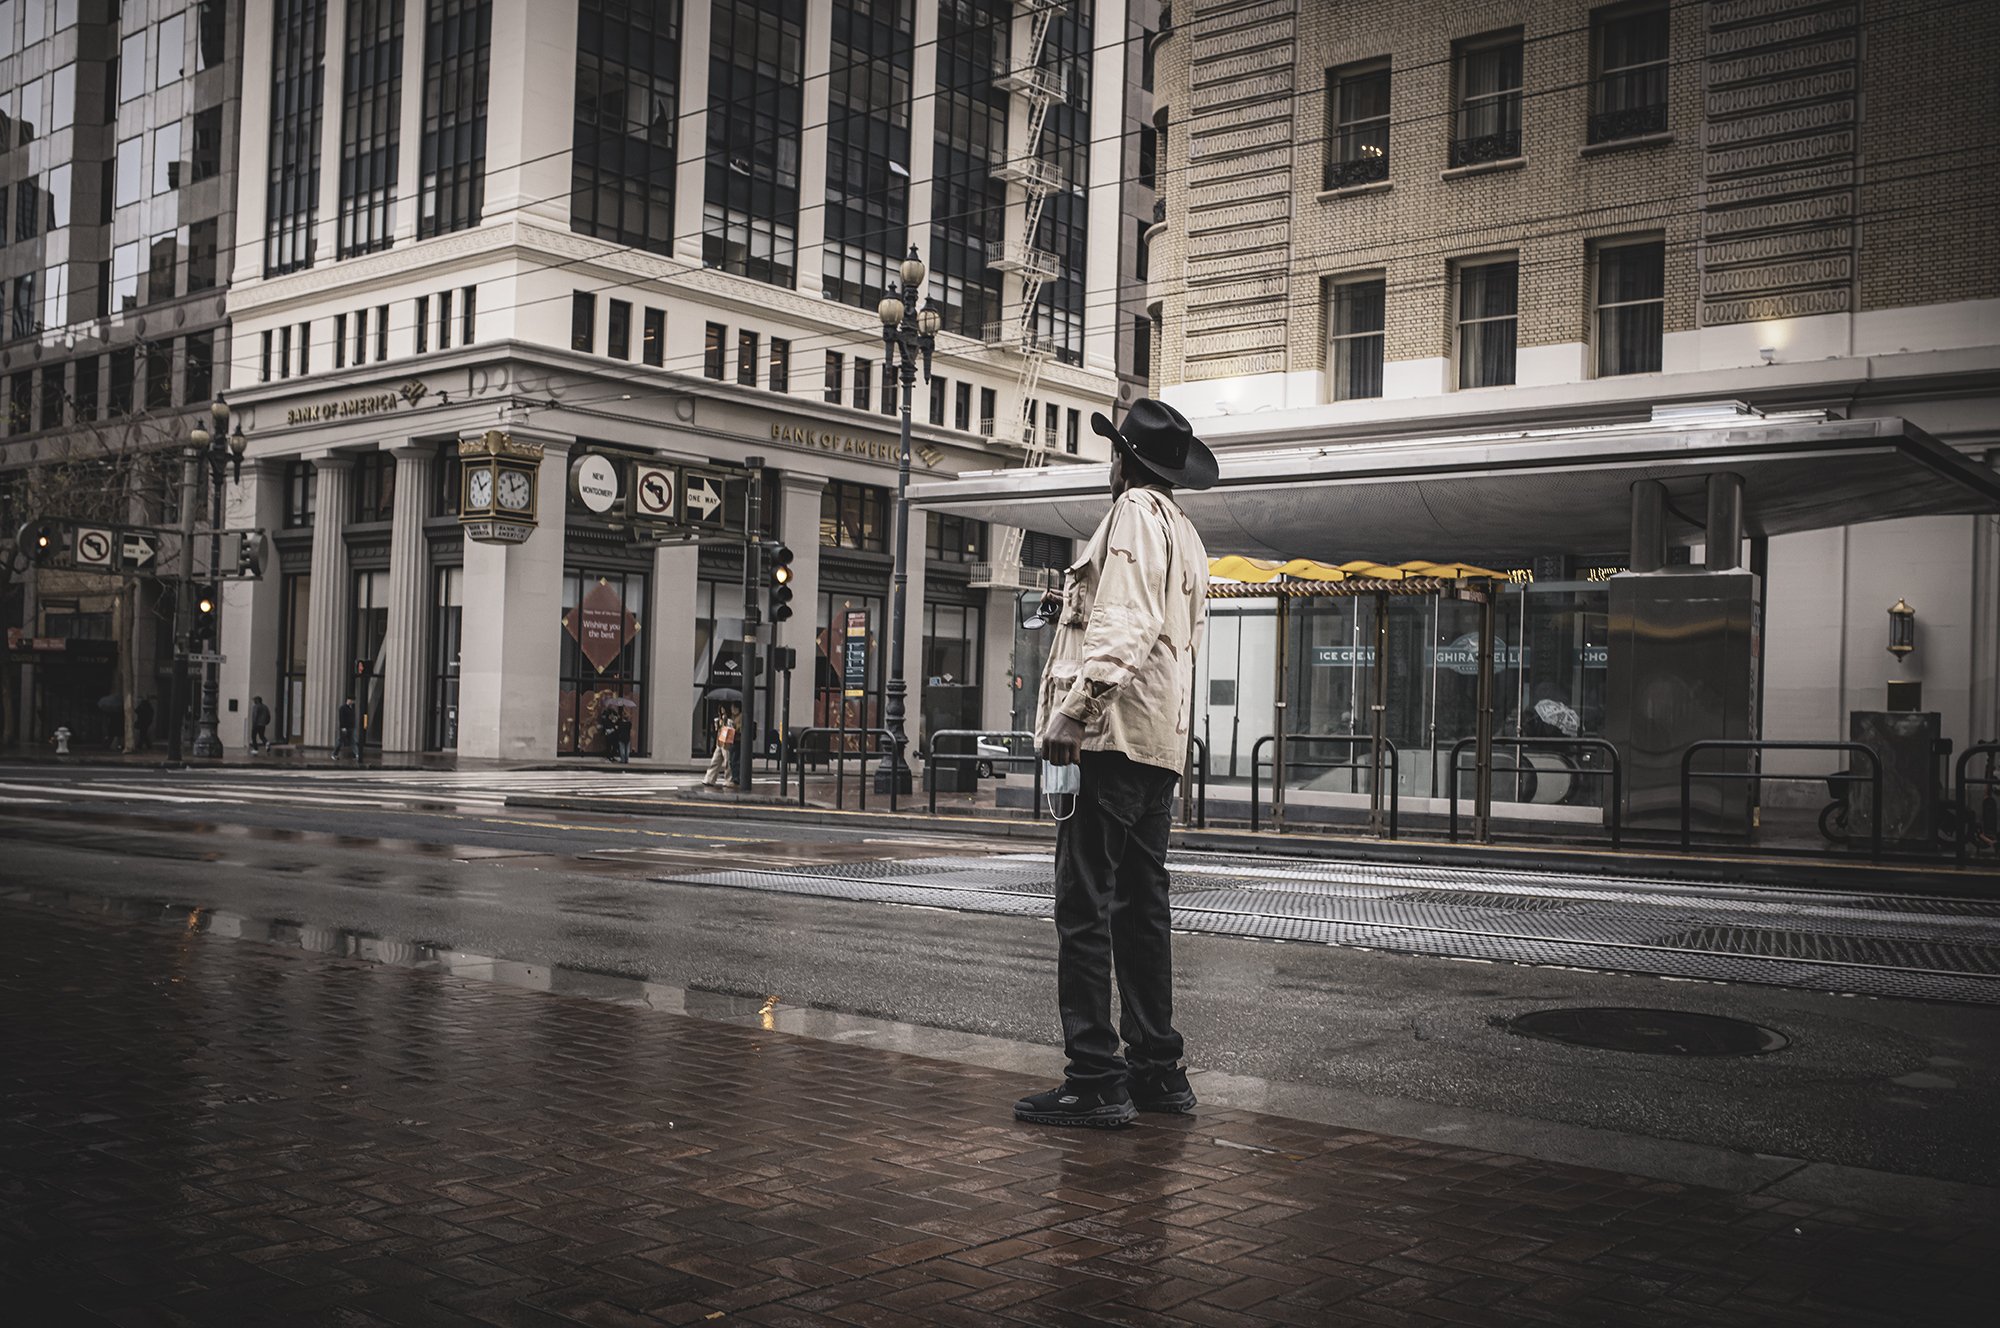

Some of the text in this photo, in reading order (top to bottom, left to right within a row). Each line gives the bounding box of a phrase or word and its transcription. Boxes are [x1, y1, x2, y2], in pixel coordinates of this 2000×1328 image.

[287, 393, 398, 425] BANK OF AMERICA
[771, 423, 912, 462] BANK OF AMERIC
[592, 472, 604, 481] NEW
[582, 486, 613, 498] MONTGOMERY
[688, 494, 717, 505] ONE WAY
[498, 531, 524, 539] AMERICA
[583, 620, 621, 632] Wishing you
[588, 630, 615, 639] the best
[1320, 652, 1338, 661] ICE
